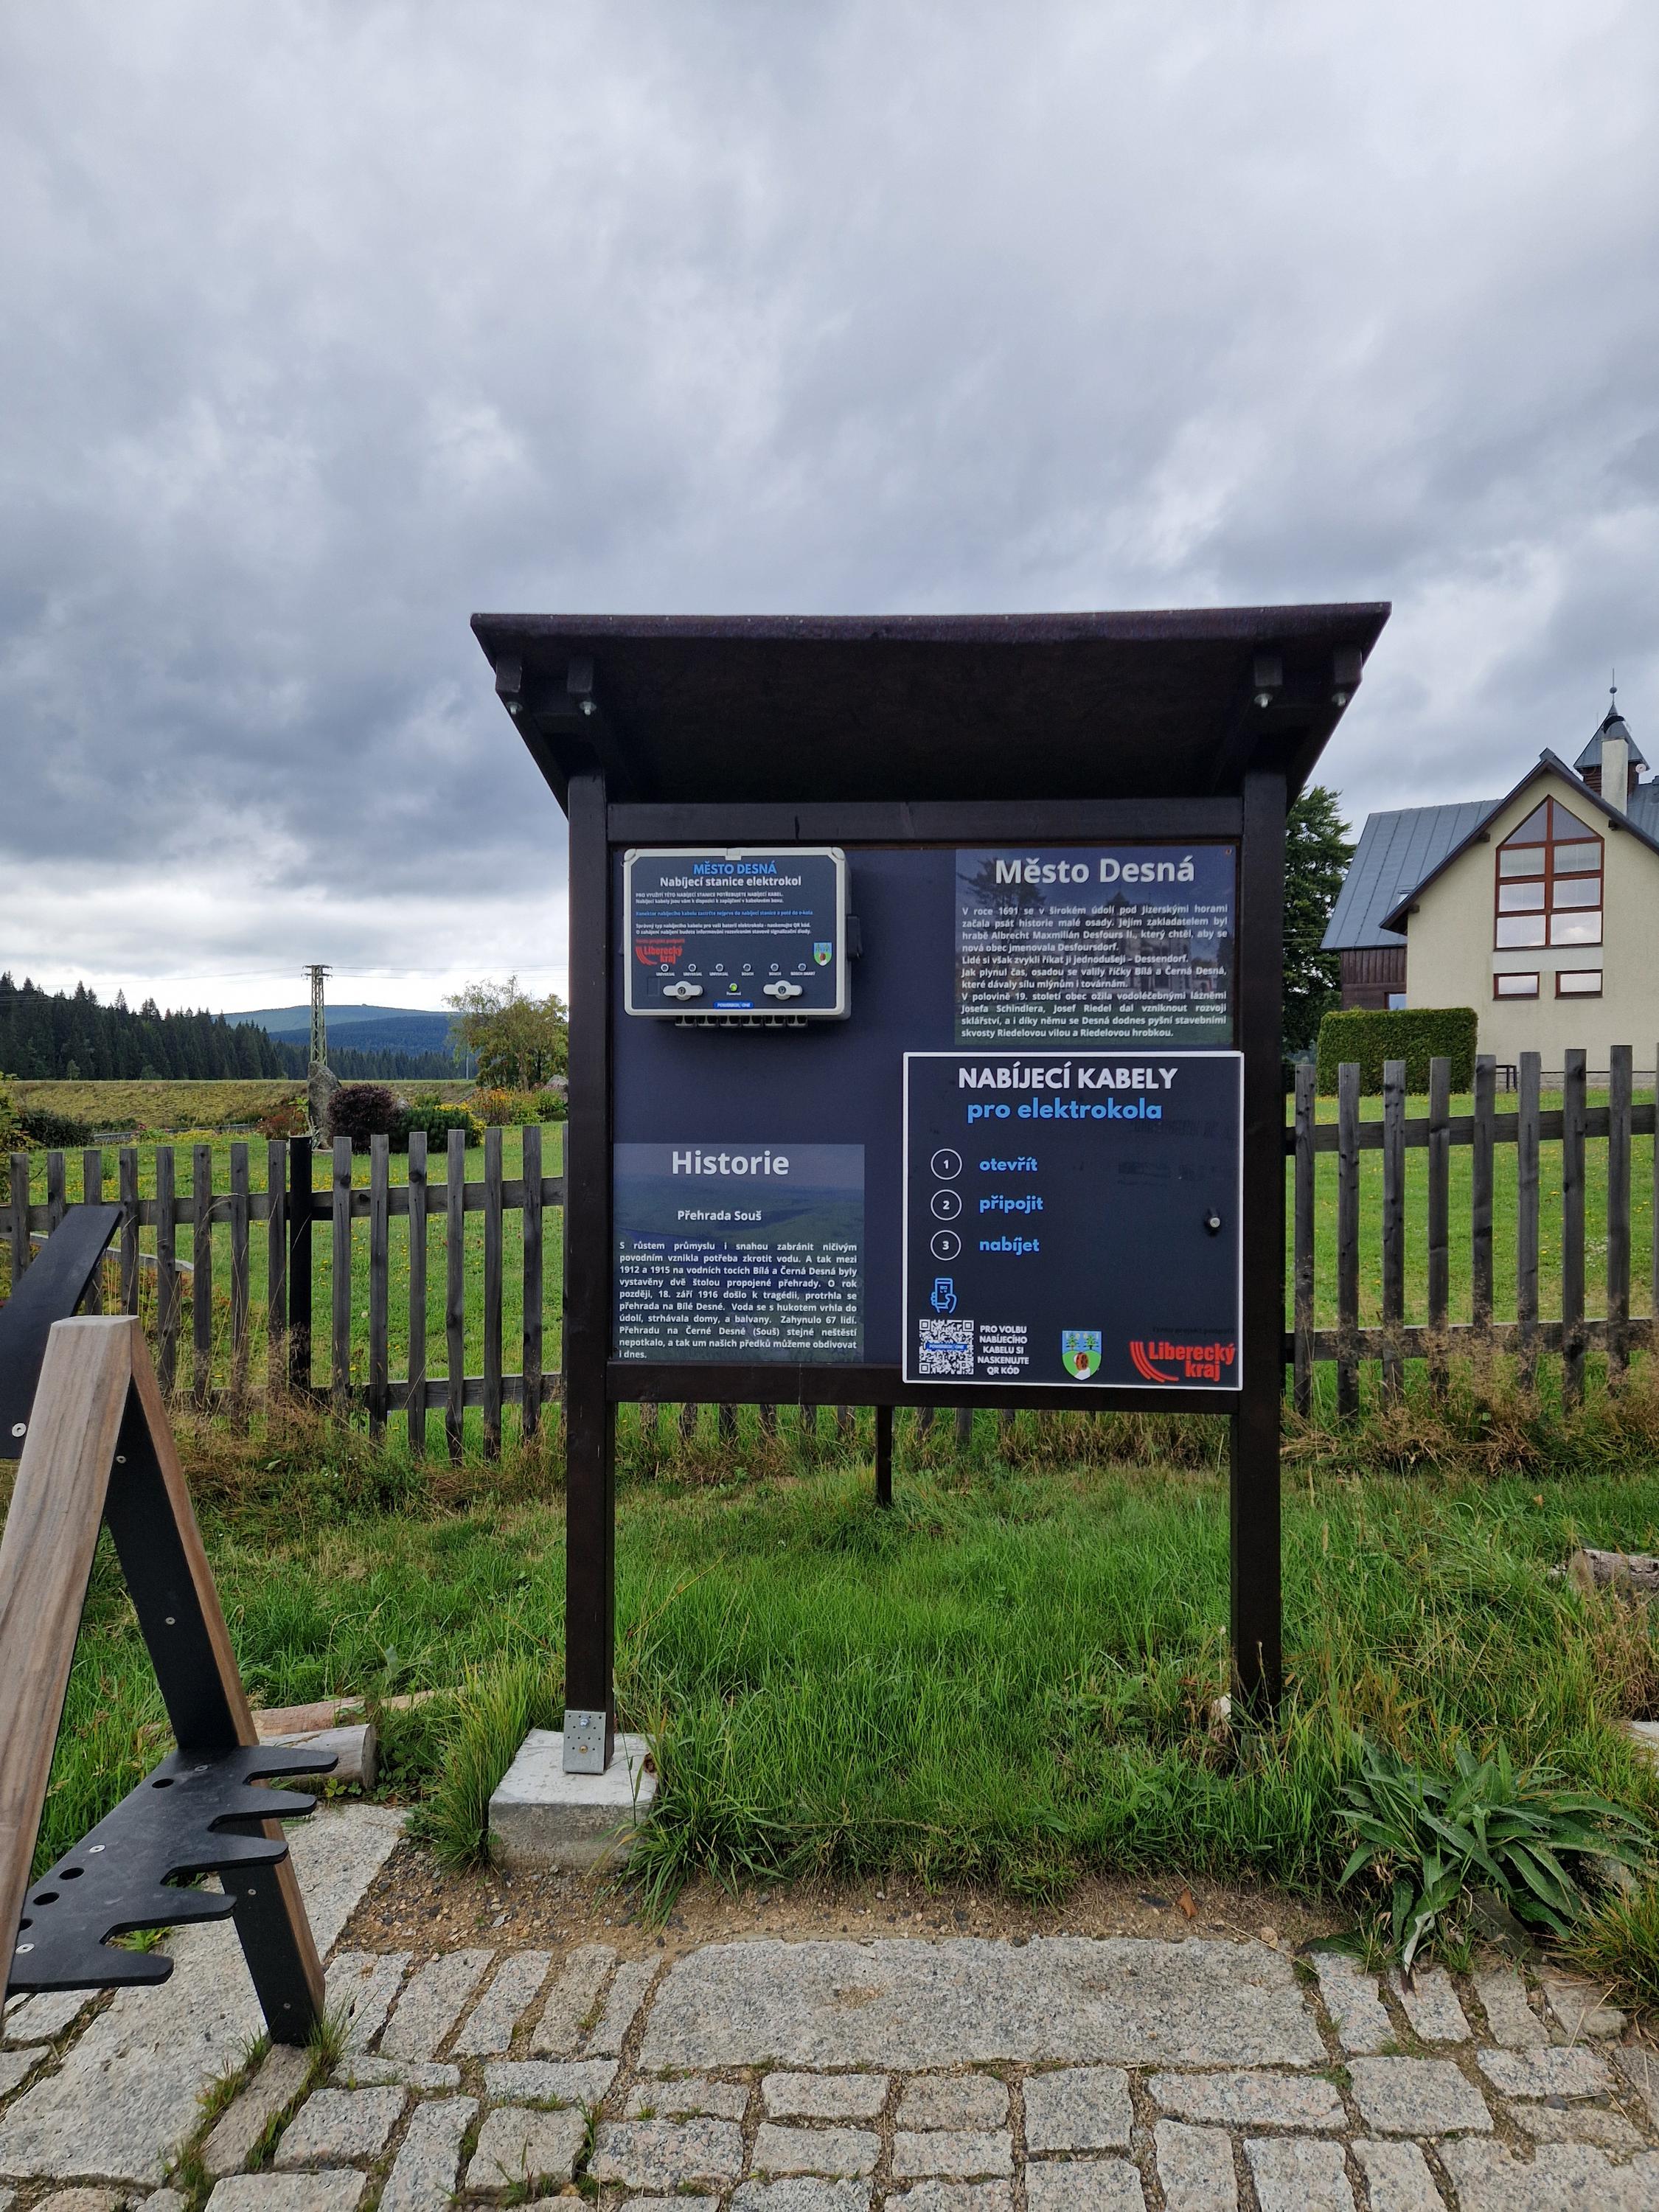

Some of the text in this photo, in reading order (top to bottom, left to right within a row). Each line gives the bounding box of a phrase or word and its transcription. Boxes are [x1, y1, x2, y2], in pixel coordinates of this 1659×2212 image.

[692, 860, 777, 874] MĚSTO DESNÁ
[995, 855, 1195, 884] Město Desná
[659, 875, 801, 888] Nabíjecí stanice elektrokol
[961, 907, 968, 915] V
[998, 905, 1018, 915] 1691
[1049, 905, 1086, 914] širokém
[1091, 904, 1114, 915] údolí
[1119, 905, 1137, 916] pod
[1141, 904, 1189, 915] Jizerskými
[1194, 903, 1228, 913] horami
[960, 1003, 1226, 1014] Josefa Schindlera, Josef Riedel dal vzniknout rozvoji
[961, 1016, 1002, 1026] sklářství,
[1012, 1016, 1016, 1024] i
[1018, 1016, 1038, 1026] díky
[1040, 1016, 1067, 1024] němu
[1081, 1016, 1110, 1024] Desná
[1111, 1016, 1146, 1024] dodnes
[1147, 1015, 1173, 1026] pyšní
[1174, 1015, 1227, 1024] stavebními
[961, 1029, 995, 1038] skvosty
[997, 1028, 1046, 1037] Riedelovou
[1048, 1029, 1071, 1037] vilou
[1079, 1028, 1130, 1037] Riedelovou
[1131, 1028, 1174, 1037] hrobkou.
[959, 1062, 1178, 1089] NABÍJECÍ KABELY
[967, 1096, 1161, 1123] pro elektrokola
[672, 1150, 790, 1176] Historie
[943, 1159, 949, 1169] 1
[979, 1156, 1038, 1172] otevřít
[942, 1200, 950, 1210] 2
[979, 1195, 1043, 1214] připojit
[677, 1209, 762, 1220] Přehrada Souš
[619, 1240, 858, 1253] S růstem průmyslu i snahou zabránit ničivým
[942, 1240, 950, 1251] 3
[979, 1236, 1040, 1256] nabíjet
[619, 1253, 663, 1263] povodním
[667, 1253, 698, 1262] vznikla
[703, 1253, 738, 1264] potřeba
[742, 1254, 772, 1262] zkrotit
[776, 1254, 801, 1263] vodu.
[816, 1254, 831, 1262] tak
[835, 1255, 857, 1263] mezi
[650, 1265, 670, 1273] 1915
[685, 1265, 721, 1273] vodních
[723, 1266, 751, 1274] tocích
[752, 1266, 770, 1274] Bílá
[779, 1265, 807, 1275] Černá
[808, 1267, 836, 1275] Desná
[838, 1267, 858, 1277] byly
[619, 1277, 664, 1287] vystavěny
[692, 1278, 720, 1286] štolou
[726, 1278, 771, 1288] propojené
[778, 1279, 821, 1289] přehrady.
[841, 1279, 857, 1287] rok
[619, 1289, 653, 1299] později,
[658, 1290, 671, 1298] 18.
[675, 1290, 693, 1298] září
[723, 1290, 747, 1298] došlo
[751, 1290, 758, 1298] k
[762, 1290, 800, 1301] tragédii,
[804, 1291, 842, 1301] protrhla
[619, 1301, 660, 1312] přehrada
[676, 1301, 693, 1310] Bílé
[695, 1302, 726, 1310] Desné.
[731, 1302, 754, 1310] Voda
[776, 1303, 817, 1311] hukotem
[818, 1303, 843, 1312] vrhla
[845, 1304, 857, 1312] do
[619, 1313, 644, 1323] údolí,
[647, 1314, 689, 1326] strhávala
[692, 1314, 720, 1324] domy,
[734, 1315, 772, 1325] balvany.
[779, 1315, 822, 1326] Zahynulo
[825, 1315, 837, 1324] 67
[840, 1315, 857, 1324] lidí.
[619, 1326, 660, 1334] Přehradu
[685, 1325, 712, 1335] Černé
[718, 1326, 746, 1335] Desné
[752, 1327, 780, 1337] (Souš)
[786, 1327, 814, 1338] stejné
[821, 1328, 858, 1336] neštěstí
[998, 1325, 1027, 1335] VOLBU
[619, 1338, 666, 1348] nepotkalo,
[675, 1338, 690, 1346] tak
[708, 1338, 737, 1347] našich
[739, 1338, 771, 1349] předků
[772, 1338, 811, 1348] můžeme
[812, 1340, 858, 1349] obdivovat
[978, 1334, 1028, 1343] NABÍJECÍHO
[618, 1349, 647, 1358] i dnes.
[982, 1346, 1024, 1354] KABELU SI
[1148, 1341, 1235, 1366] Liberecký
[976, 1356, 1029, 1366] NASKENUJTE
[986, 1365, 1020, 1375] QR KÓD
[1185, 1360, 1220, 1382] kraj
